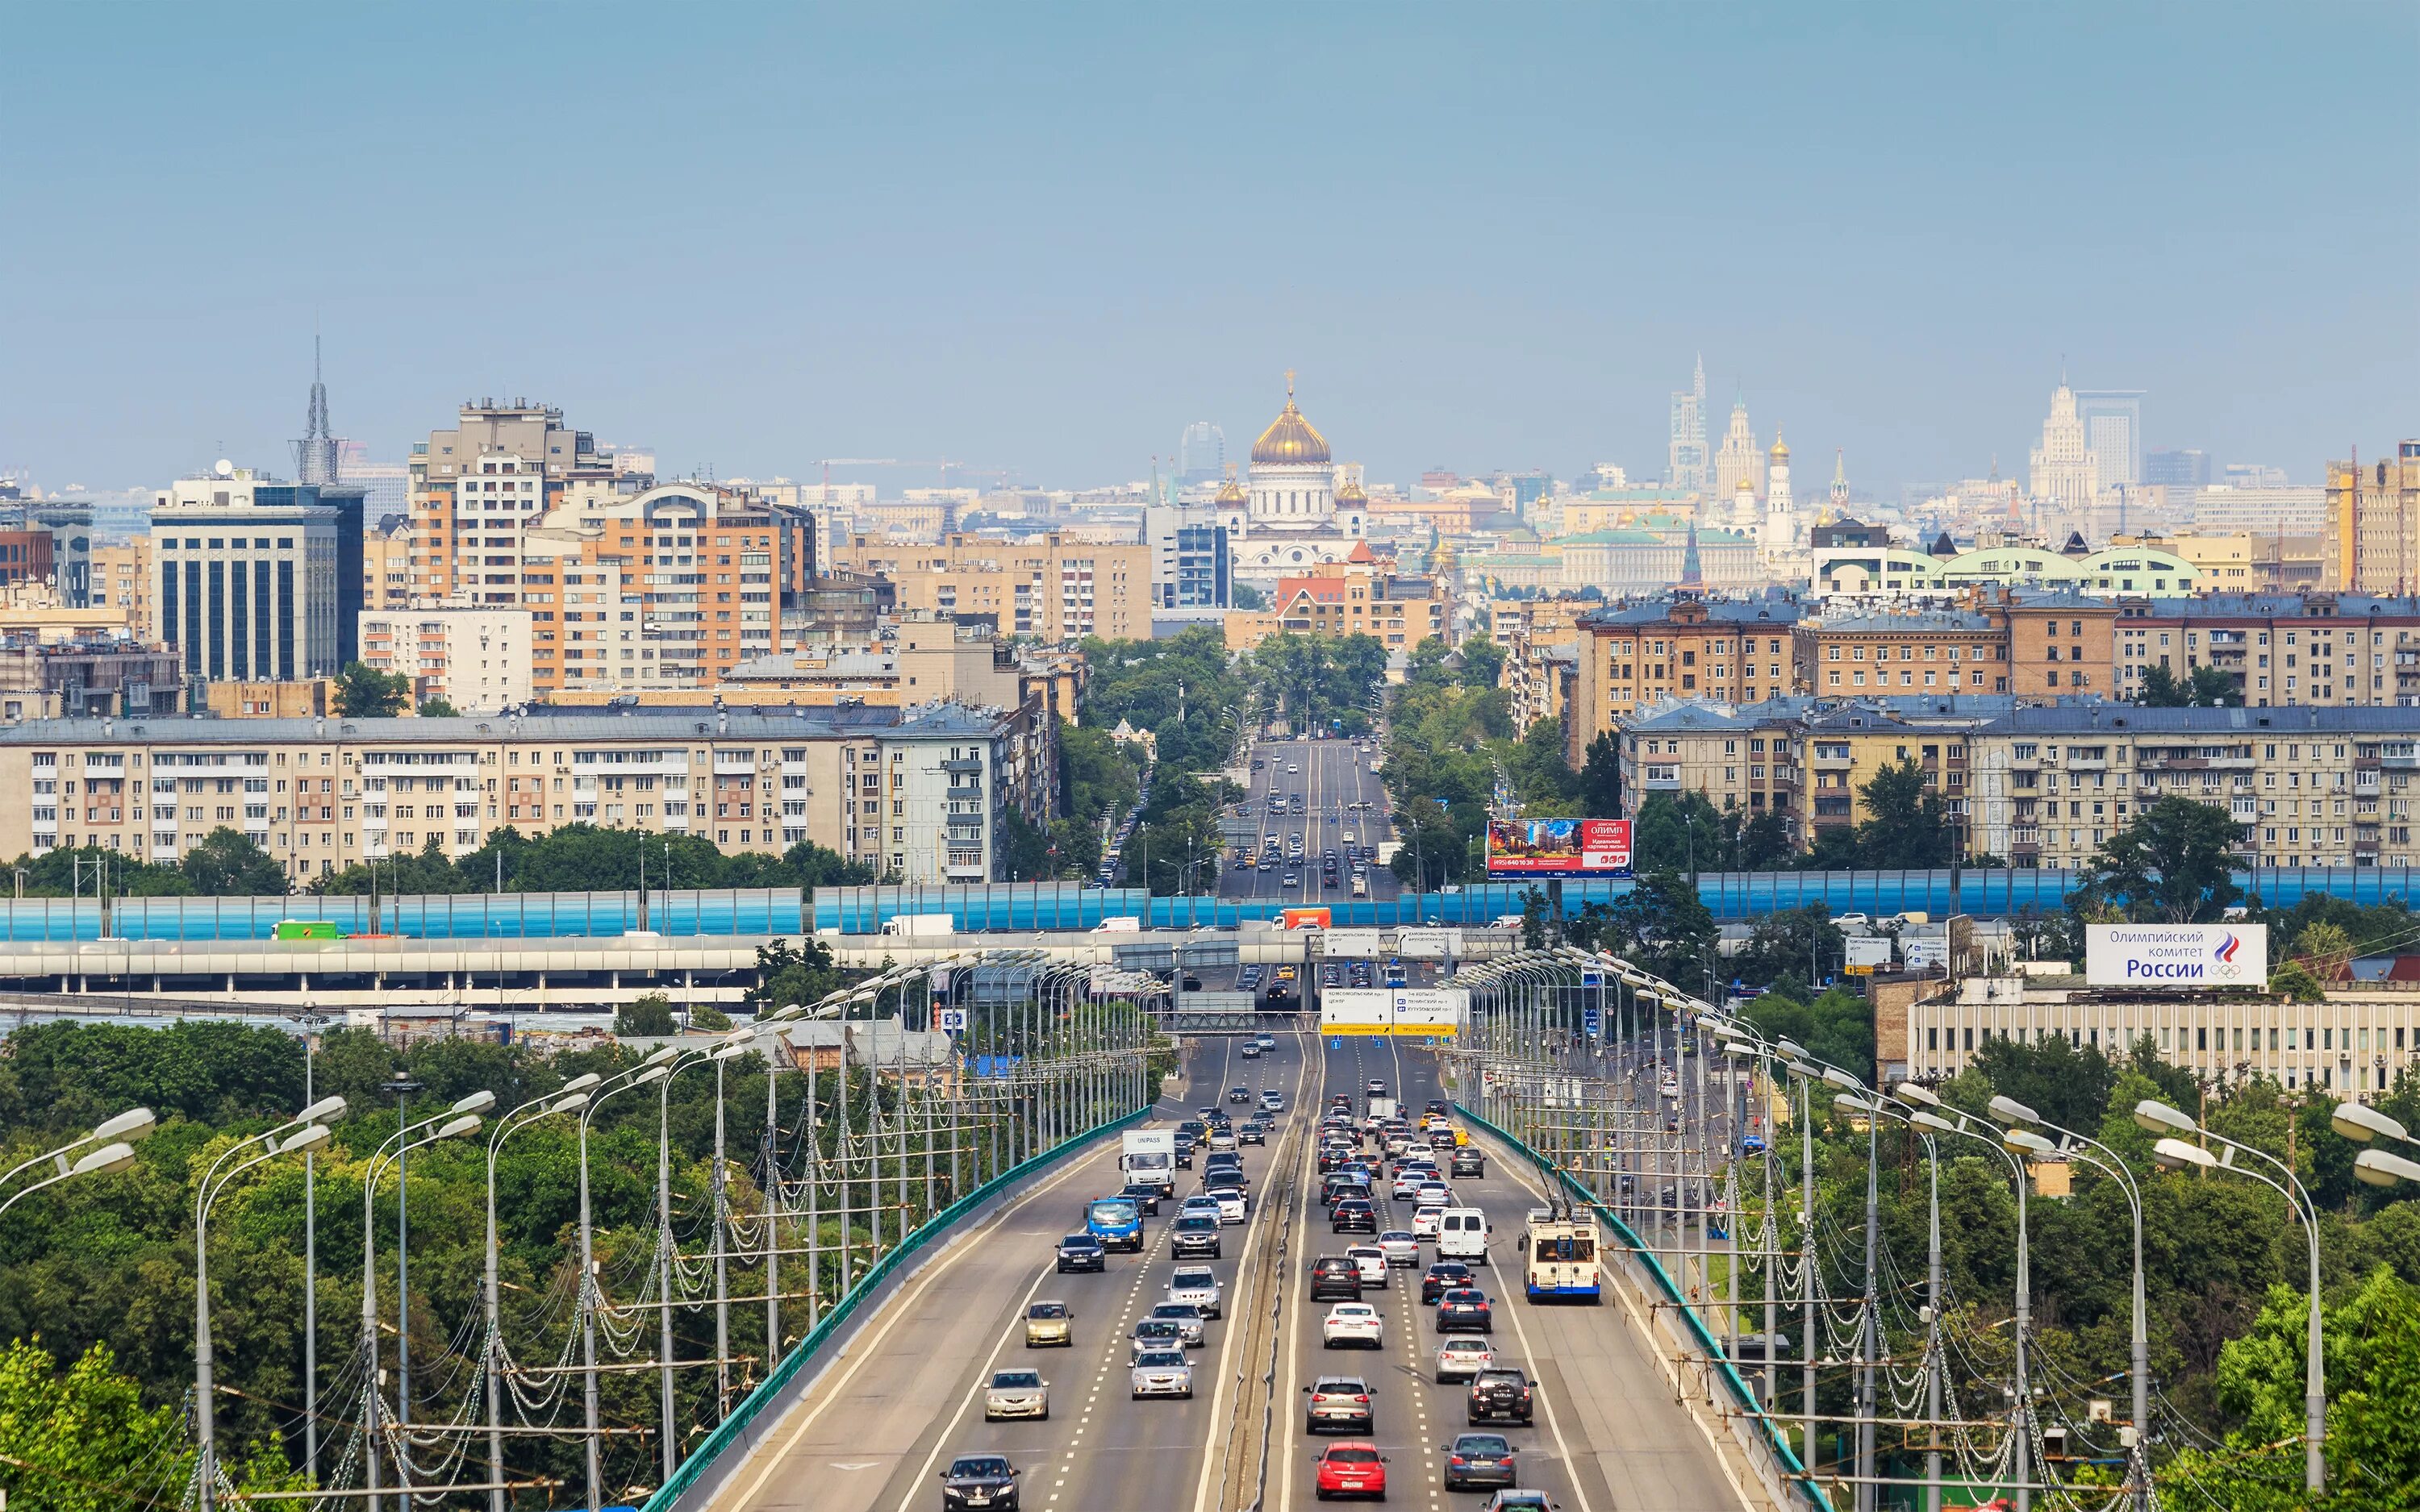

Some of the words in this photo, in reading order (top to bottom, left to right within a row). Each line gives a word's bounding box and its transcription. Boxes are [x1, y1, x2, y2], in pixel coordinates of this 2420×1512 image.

[1591, 827, 1623, 835] ОЛИМП
[2109, 930, 2205, 943] Олимпийский
[2147, 947, 2204, 958] комитет
[2126, 959, 2204, 978] России
